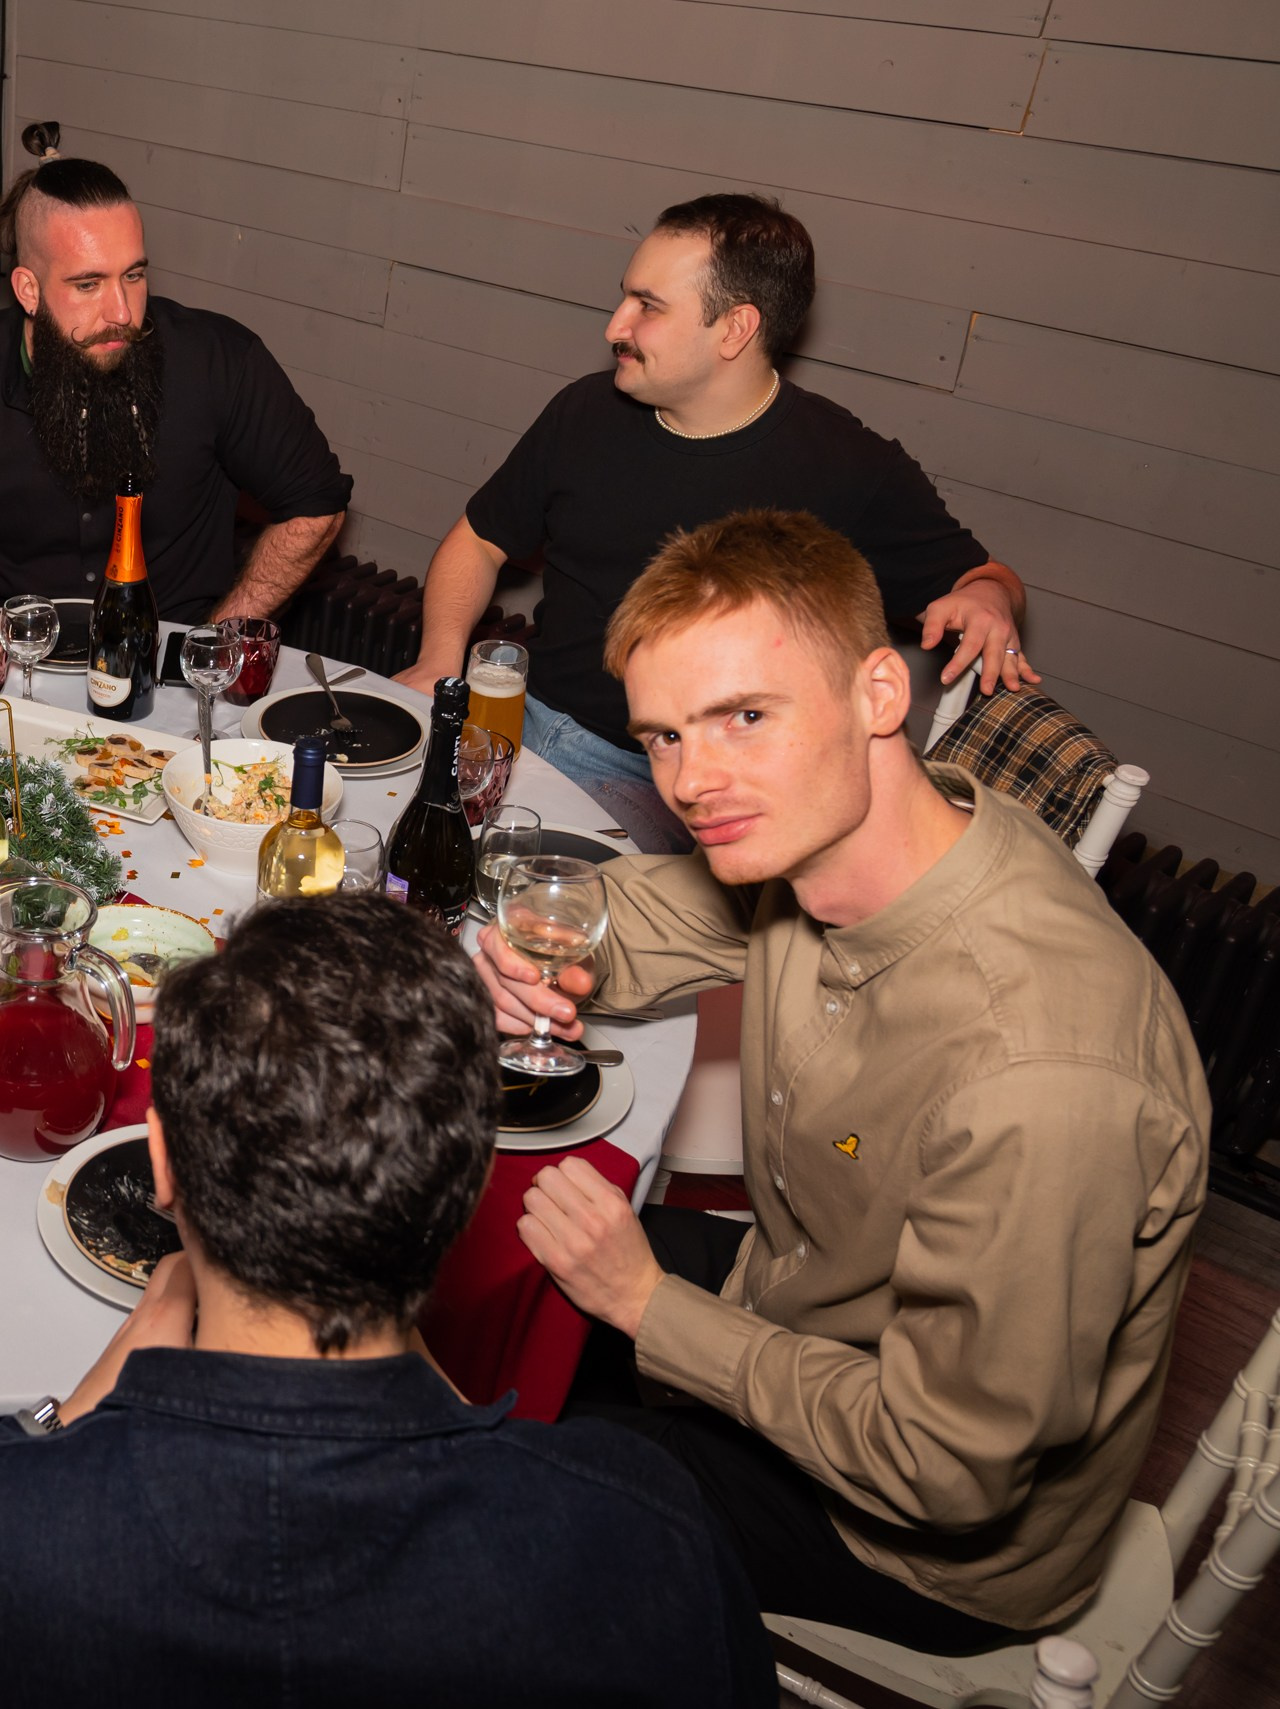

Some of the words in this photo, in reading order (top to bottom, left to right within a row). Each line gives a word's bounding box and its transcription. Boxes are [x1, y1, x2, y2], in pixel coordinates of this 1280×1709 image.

[116, 506, 124, 542] CINZANO
[90, 677, 117, 692] CINZANO
[451, 735, 461, 777] CANTI
